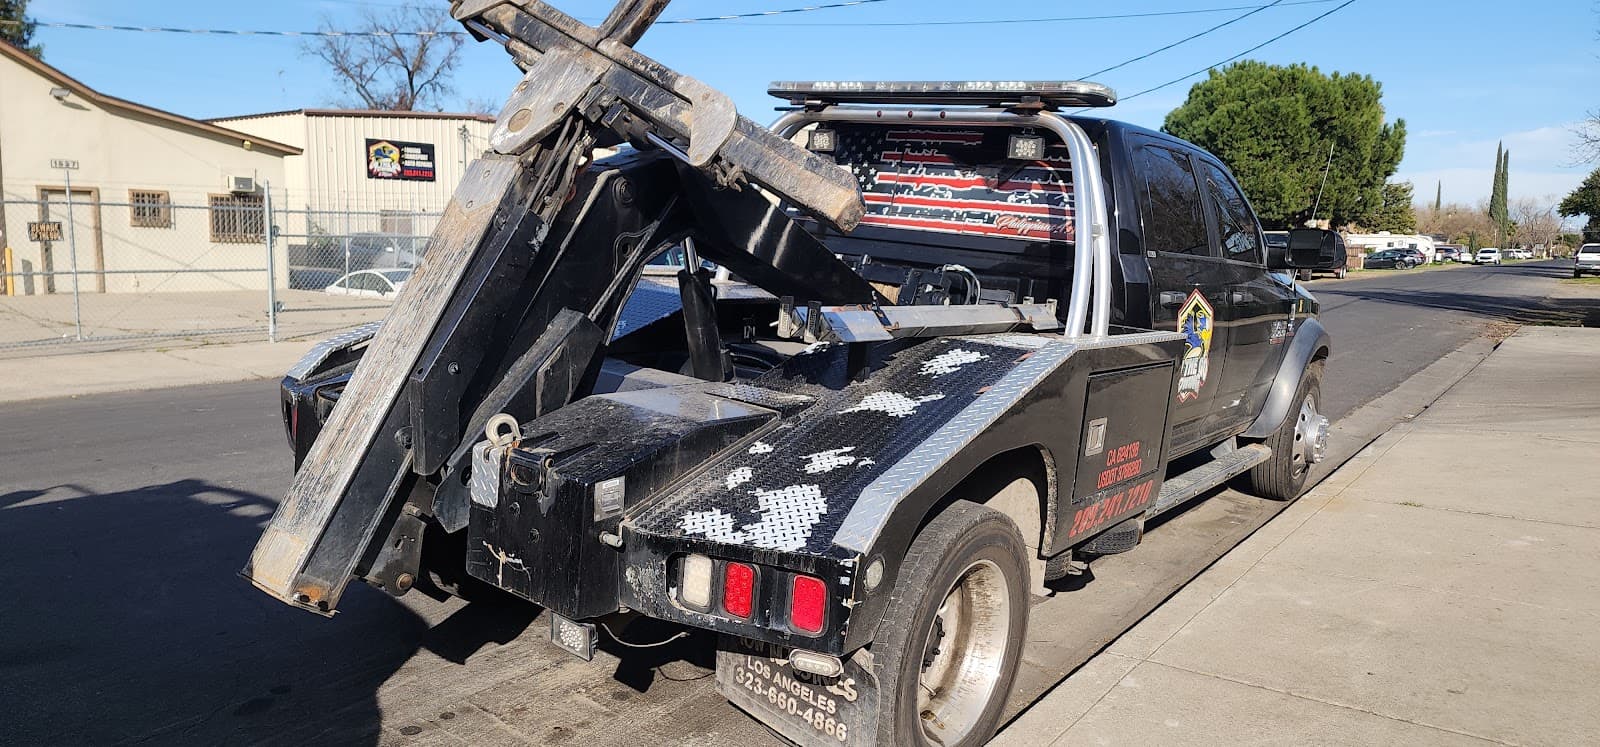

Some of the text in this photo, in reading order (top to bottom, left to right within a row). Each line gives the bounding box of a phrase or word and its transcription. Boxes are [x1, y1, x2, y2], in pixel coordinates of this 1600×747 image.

[1107, 449, 1116, 466] CA
[1098, 468, 1118, 489] USDOT
[735, 666, 848, 742] 323-660-4866
[747, 656, 771, 679] LOS
[773, 672, 837, 715] ANGELES
